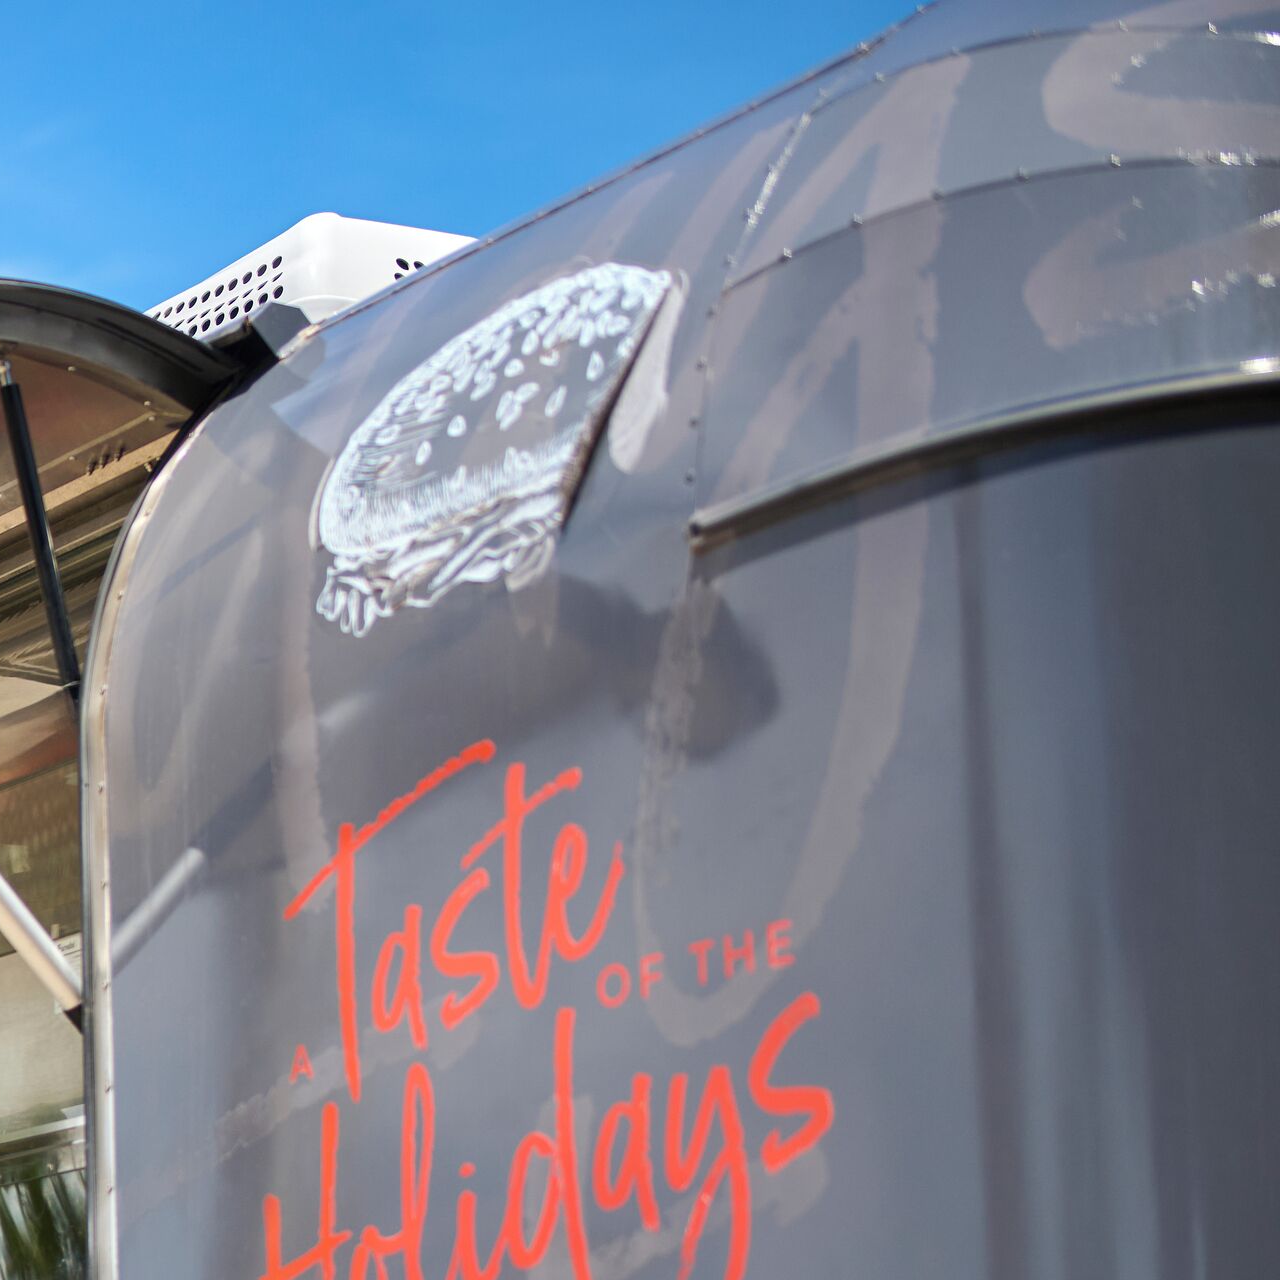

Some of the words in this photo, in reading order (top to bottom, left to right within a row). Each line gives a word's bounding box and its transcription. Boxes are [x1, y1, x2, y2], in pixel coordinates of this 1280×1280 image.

[283, 738, 625, 1103] Taste
[596, 952, 664, 1008] OF
[688, 918, 796, 986] THE
[289, 1044, 314, 1083] A
